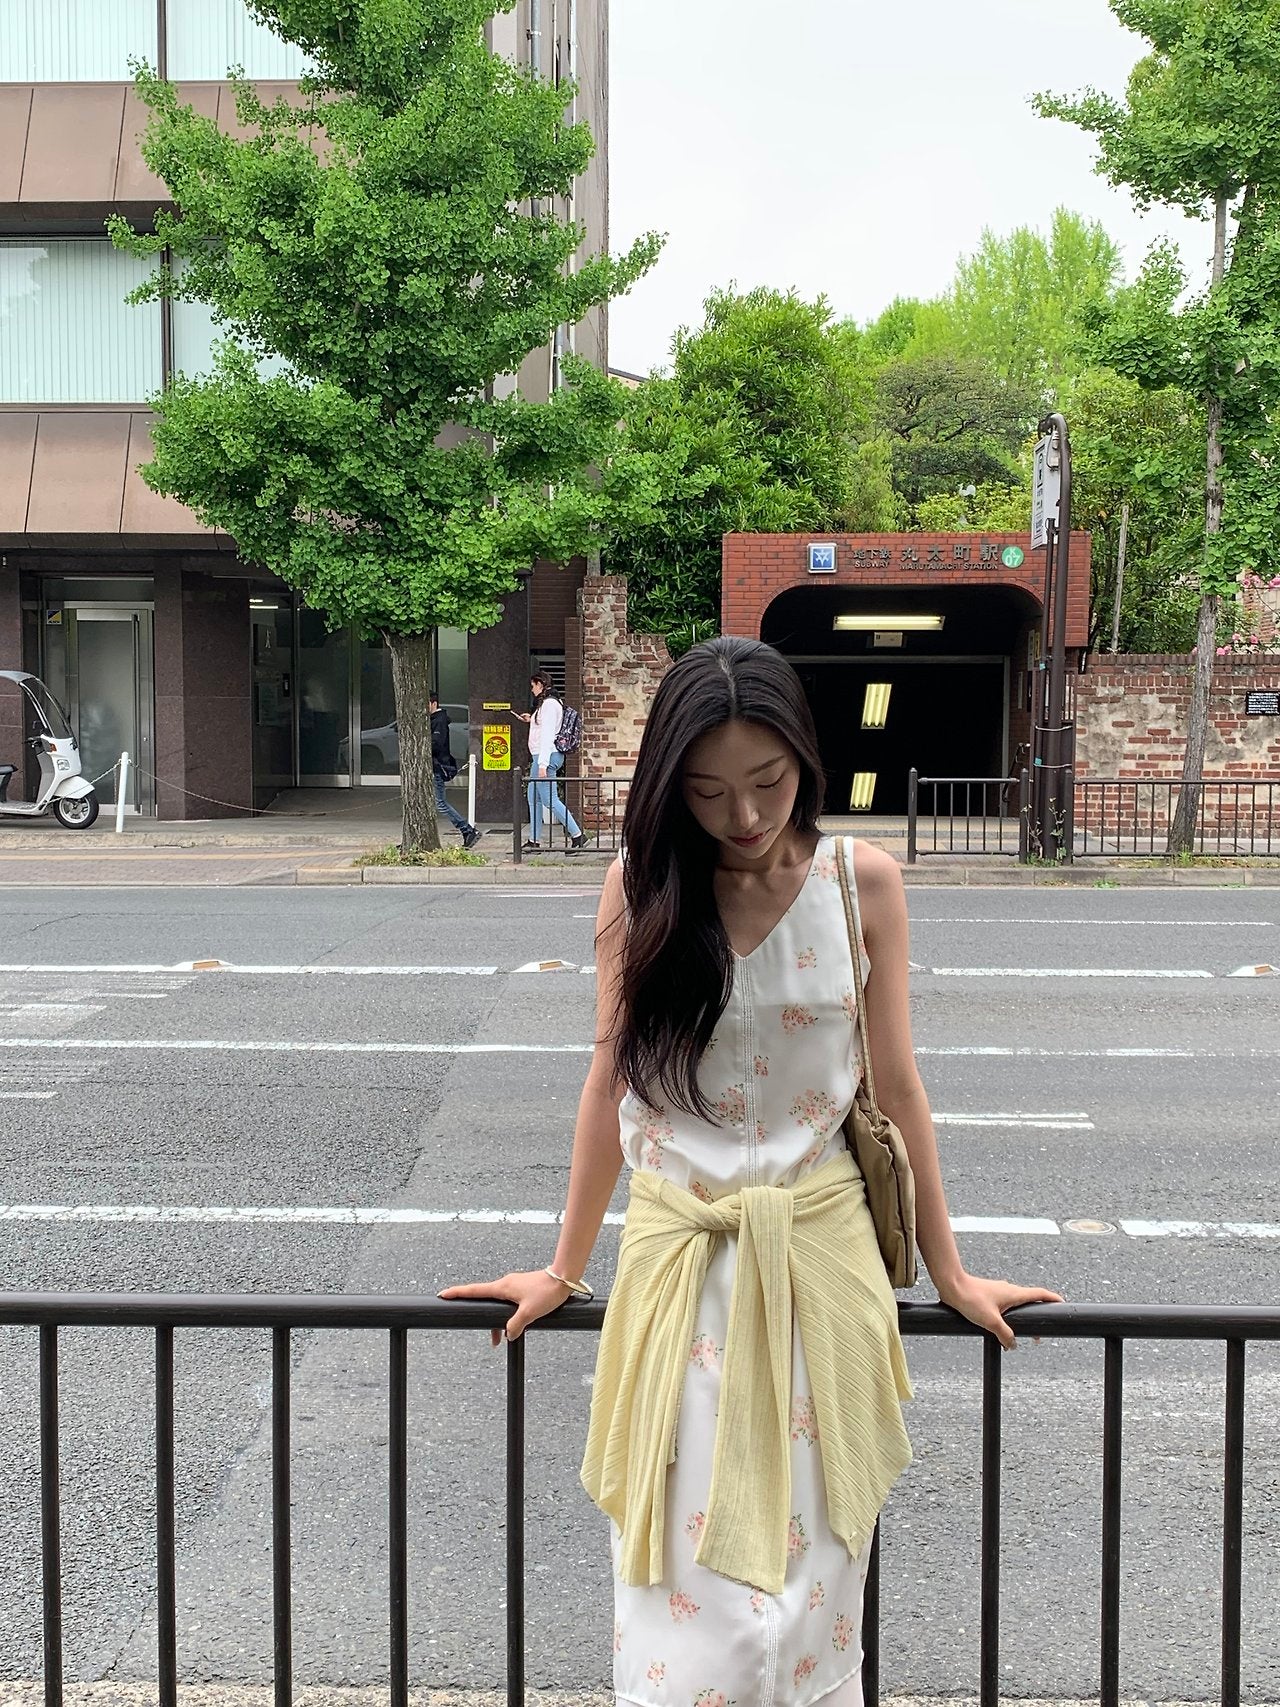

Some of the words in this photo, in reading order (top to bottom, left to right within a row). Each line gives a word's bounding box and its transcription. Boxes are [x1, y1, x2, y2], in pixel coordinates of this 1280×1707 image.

[853, 548, 891, 560] 地下鉄
[900, 544, 998, 561] 丸太町駅
[854, 560, 889, 569] SUBWAY
[1005, 555, 1020, 566] 07
